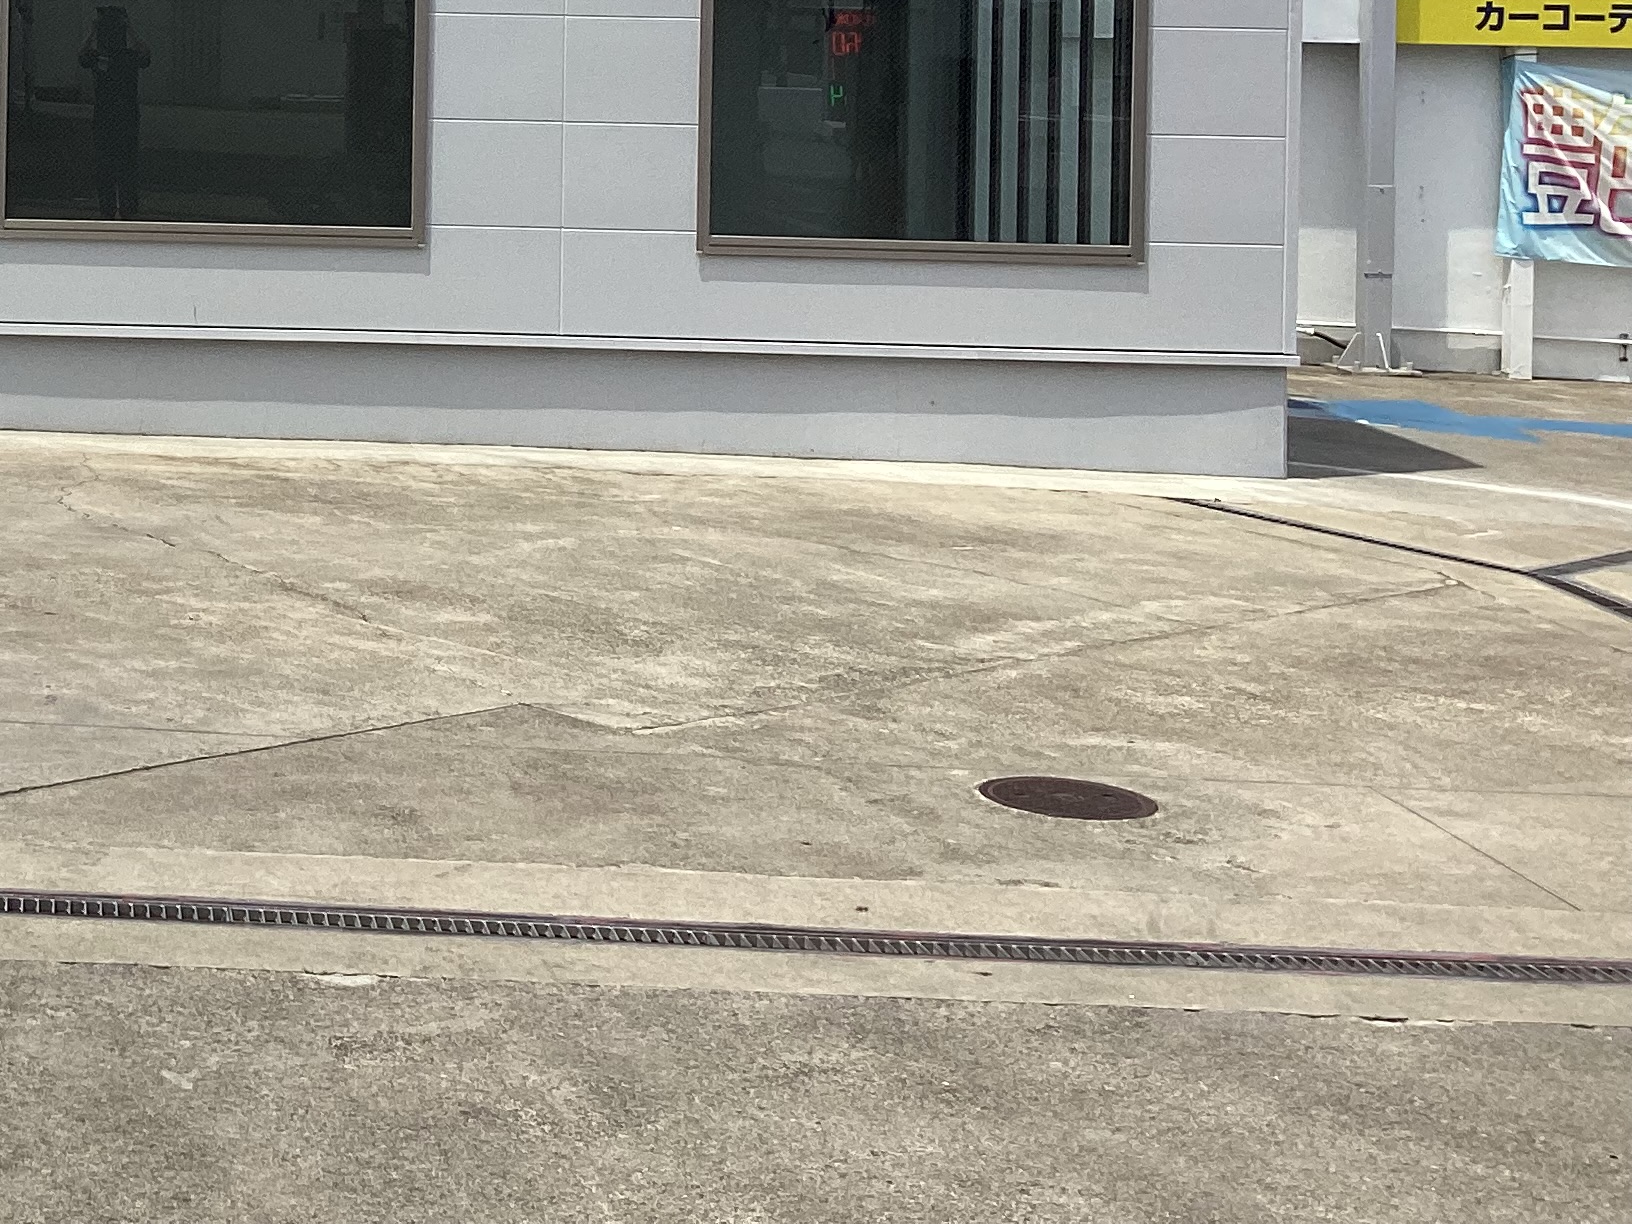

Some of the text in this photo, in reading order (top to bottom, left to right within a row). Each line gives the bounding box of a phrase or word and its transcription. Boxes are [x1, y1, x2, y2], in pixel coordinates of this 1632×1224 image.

[1475, 0, 1632, 34] カーコーテ
